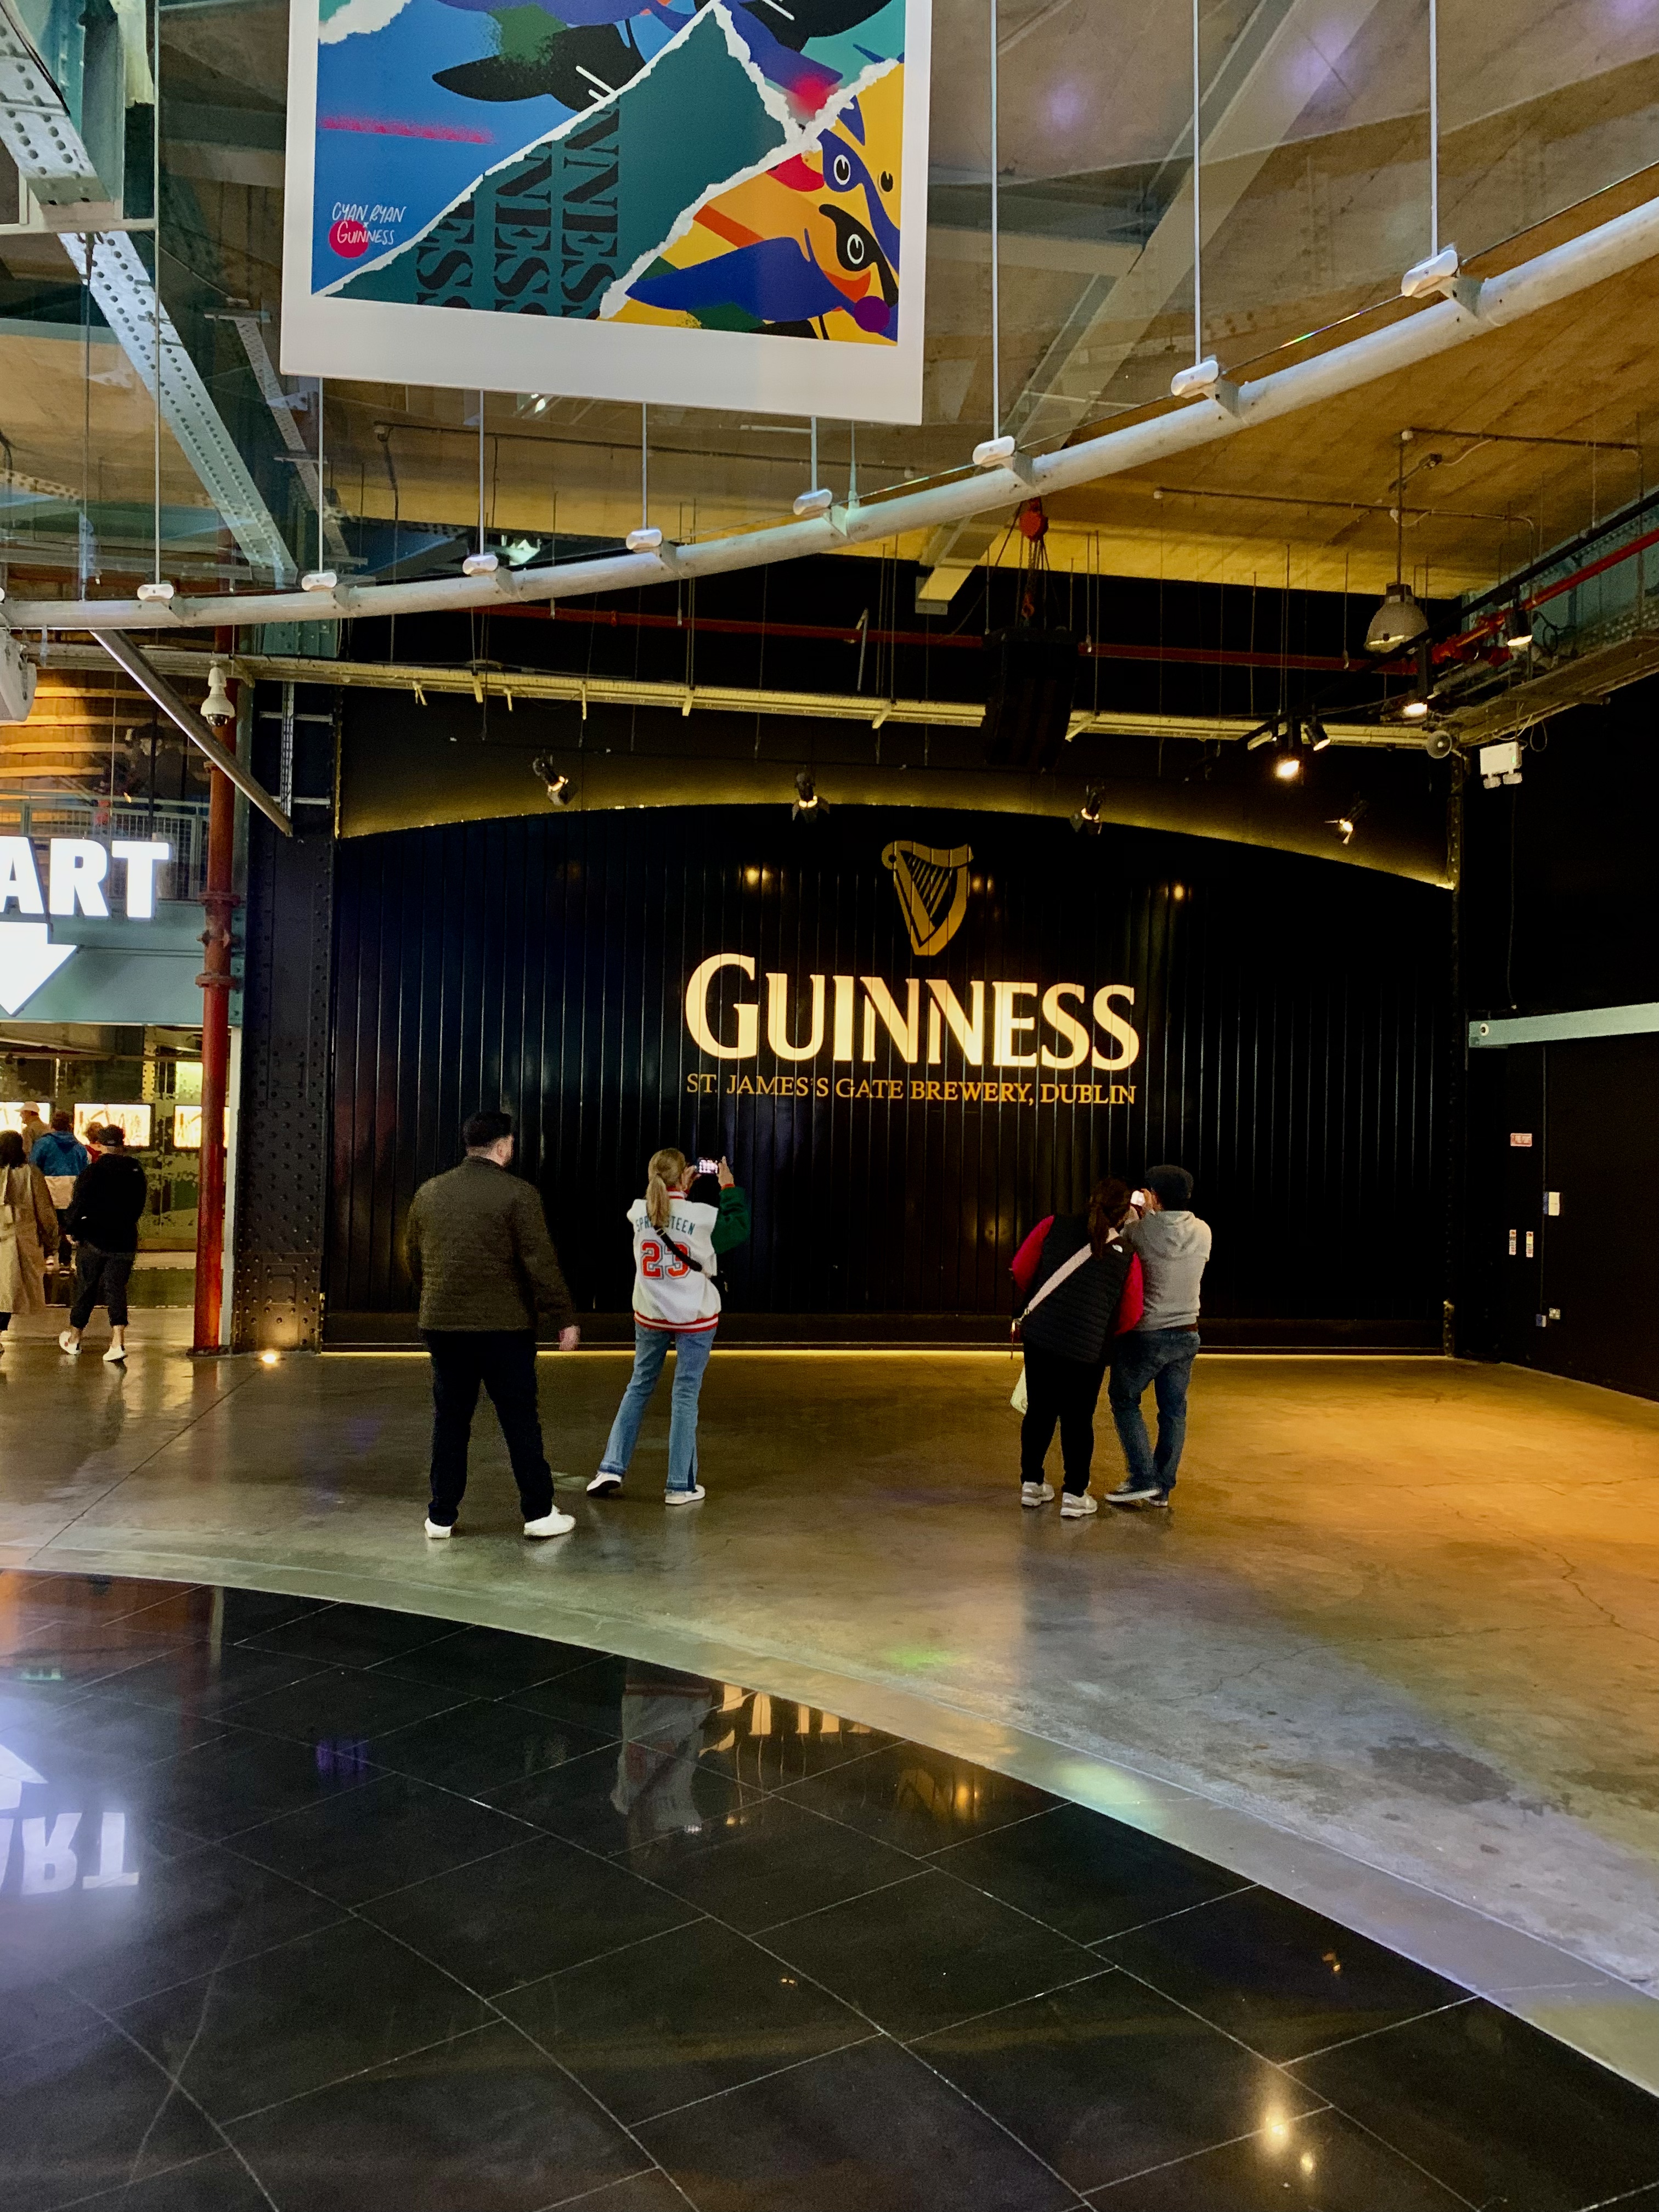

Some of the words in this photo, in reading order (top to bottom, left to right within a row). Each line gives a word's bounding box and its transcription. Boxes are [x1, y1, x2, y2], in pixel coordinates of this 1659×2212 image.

[332, 201, 368, 222] CYAN
[369, 204, 407, 224] RYAN
[685, 952, 1141, 1071] GUINNESS
[726, 1075, 829, 1097] JAMES'S
[835, 1077, 904, 1099] GATE
[910, 1080, 1034, 1106] BREWERY,
[1040, 1083, 1137, 1105] DUBLIN
[640, 1239, 691, 1280] 23
